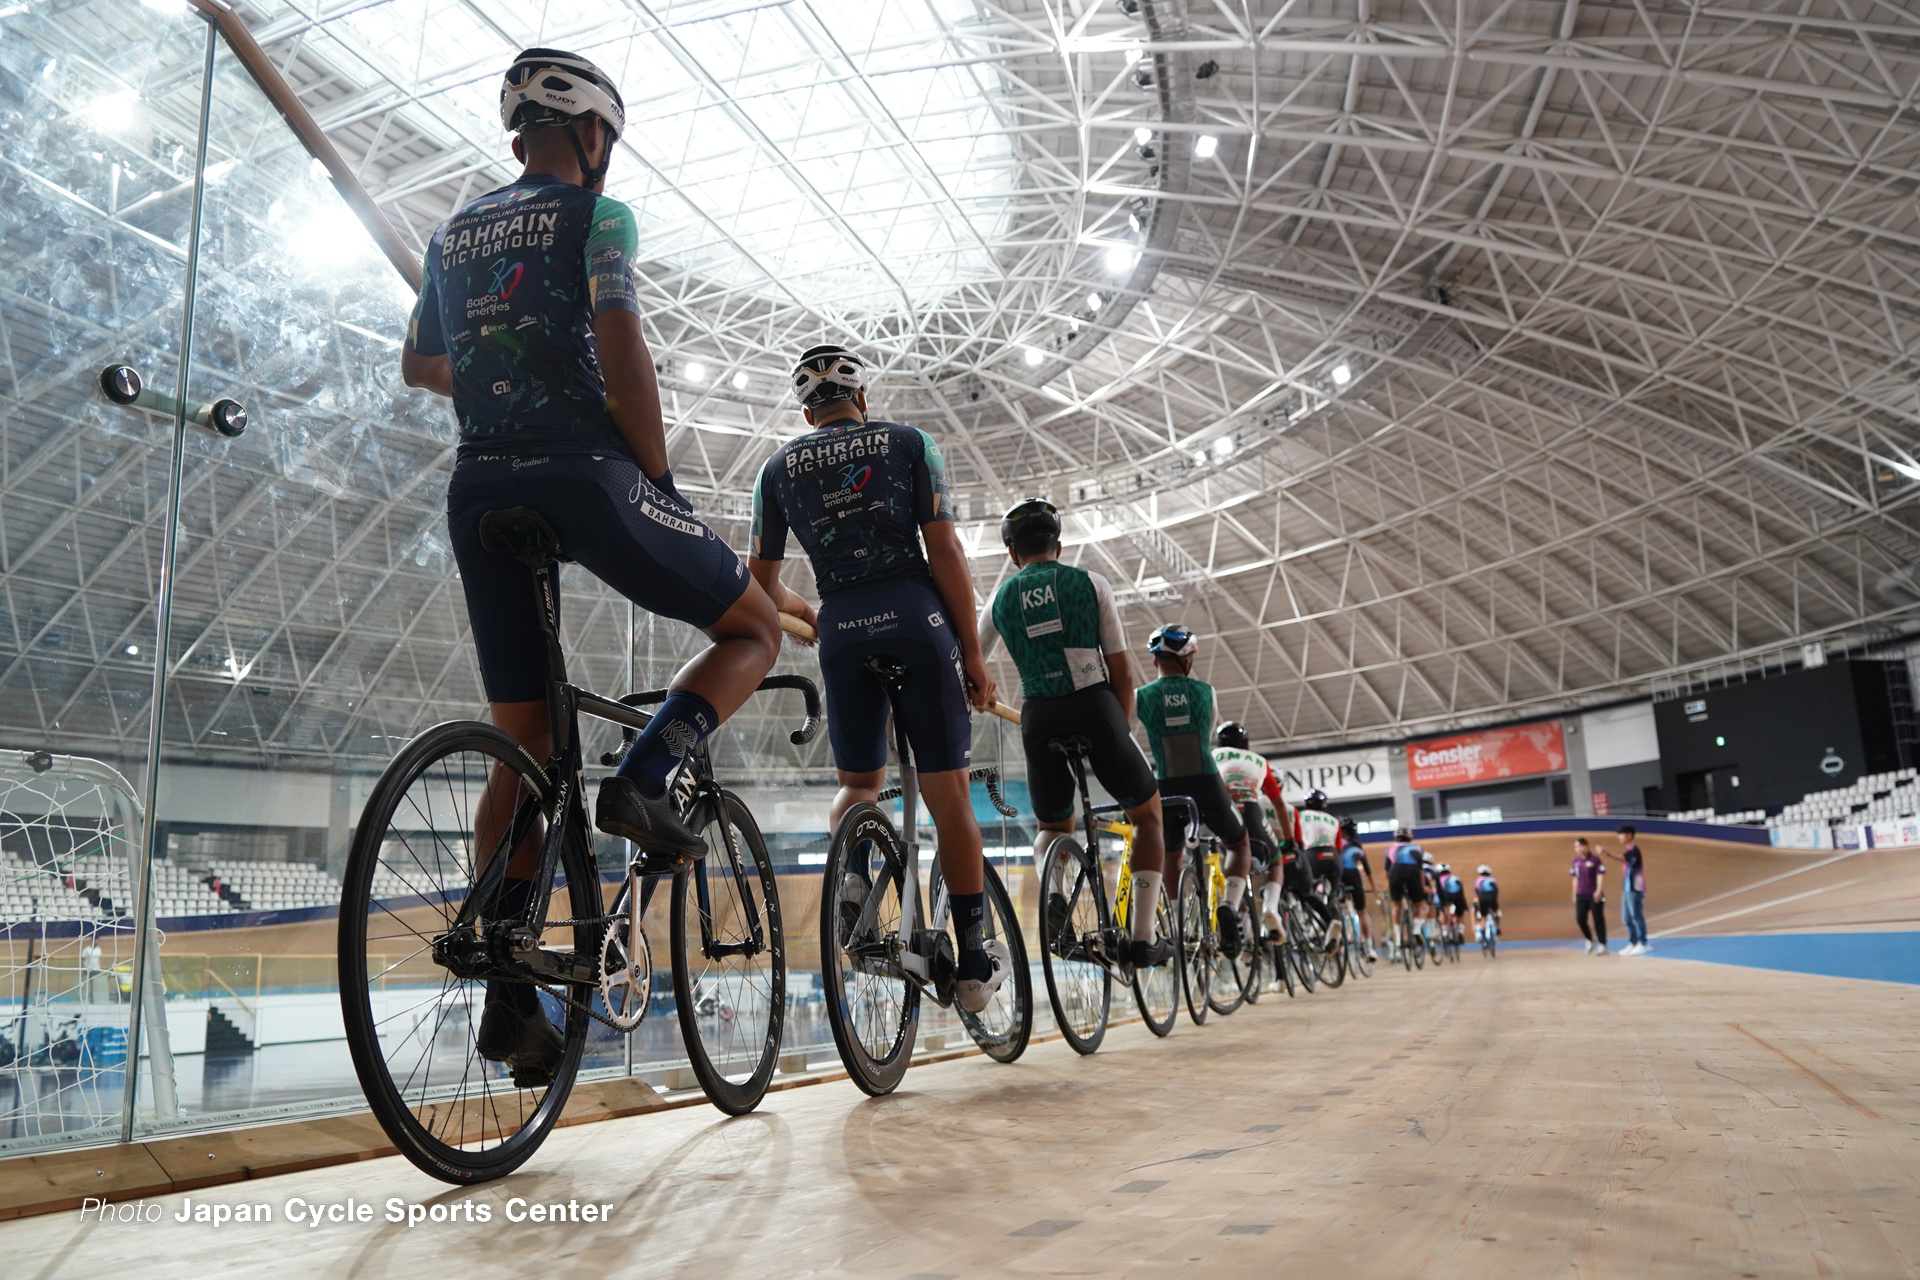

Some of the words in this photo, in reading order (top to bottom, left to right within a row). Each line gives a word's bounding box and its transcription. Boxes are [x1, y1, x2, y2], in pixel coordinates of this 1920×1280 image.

[546, 93, 577, 107] RUDY
[448, 216, 480, 232] BAHRAIN
[481, 208, 516, 222] CYCLING
[518, 202, 562, 212] ACADEMY
[442, 212, 558, 256] BAHRAIN
[442, 233, 555, 271] VICTORIOUS
[466, 294, 498, 309] Bapco
[467, 302, 510, 318] energies
[818, 435, 850, 444] CYCLING
[786, 433, 889, 469] BAHRAIN
[788, 445, 889, 478] VICTORIOUS
[822, 488, 851, 502] Bapco
[824, 492, 863, 508] energies
[648, 507, 696, 534] BAHRAIN
[1022, 584, 1056, 610] KSA
[838, 611, 898, 630] NATURAL
[1165, 694, 1188, 707] KSA
[1215, 751, 1263, 768] OMAN
[1414, 743, 1482, 768] Gensler
[1284, 761, 1376, 792] NIPPO
